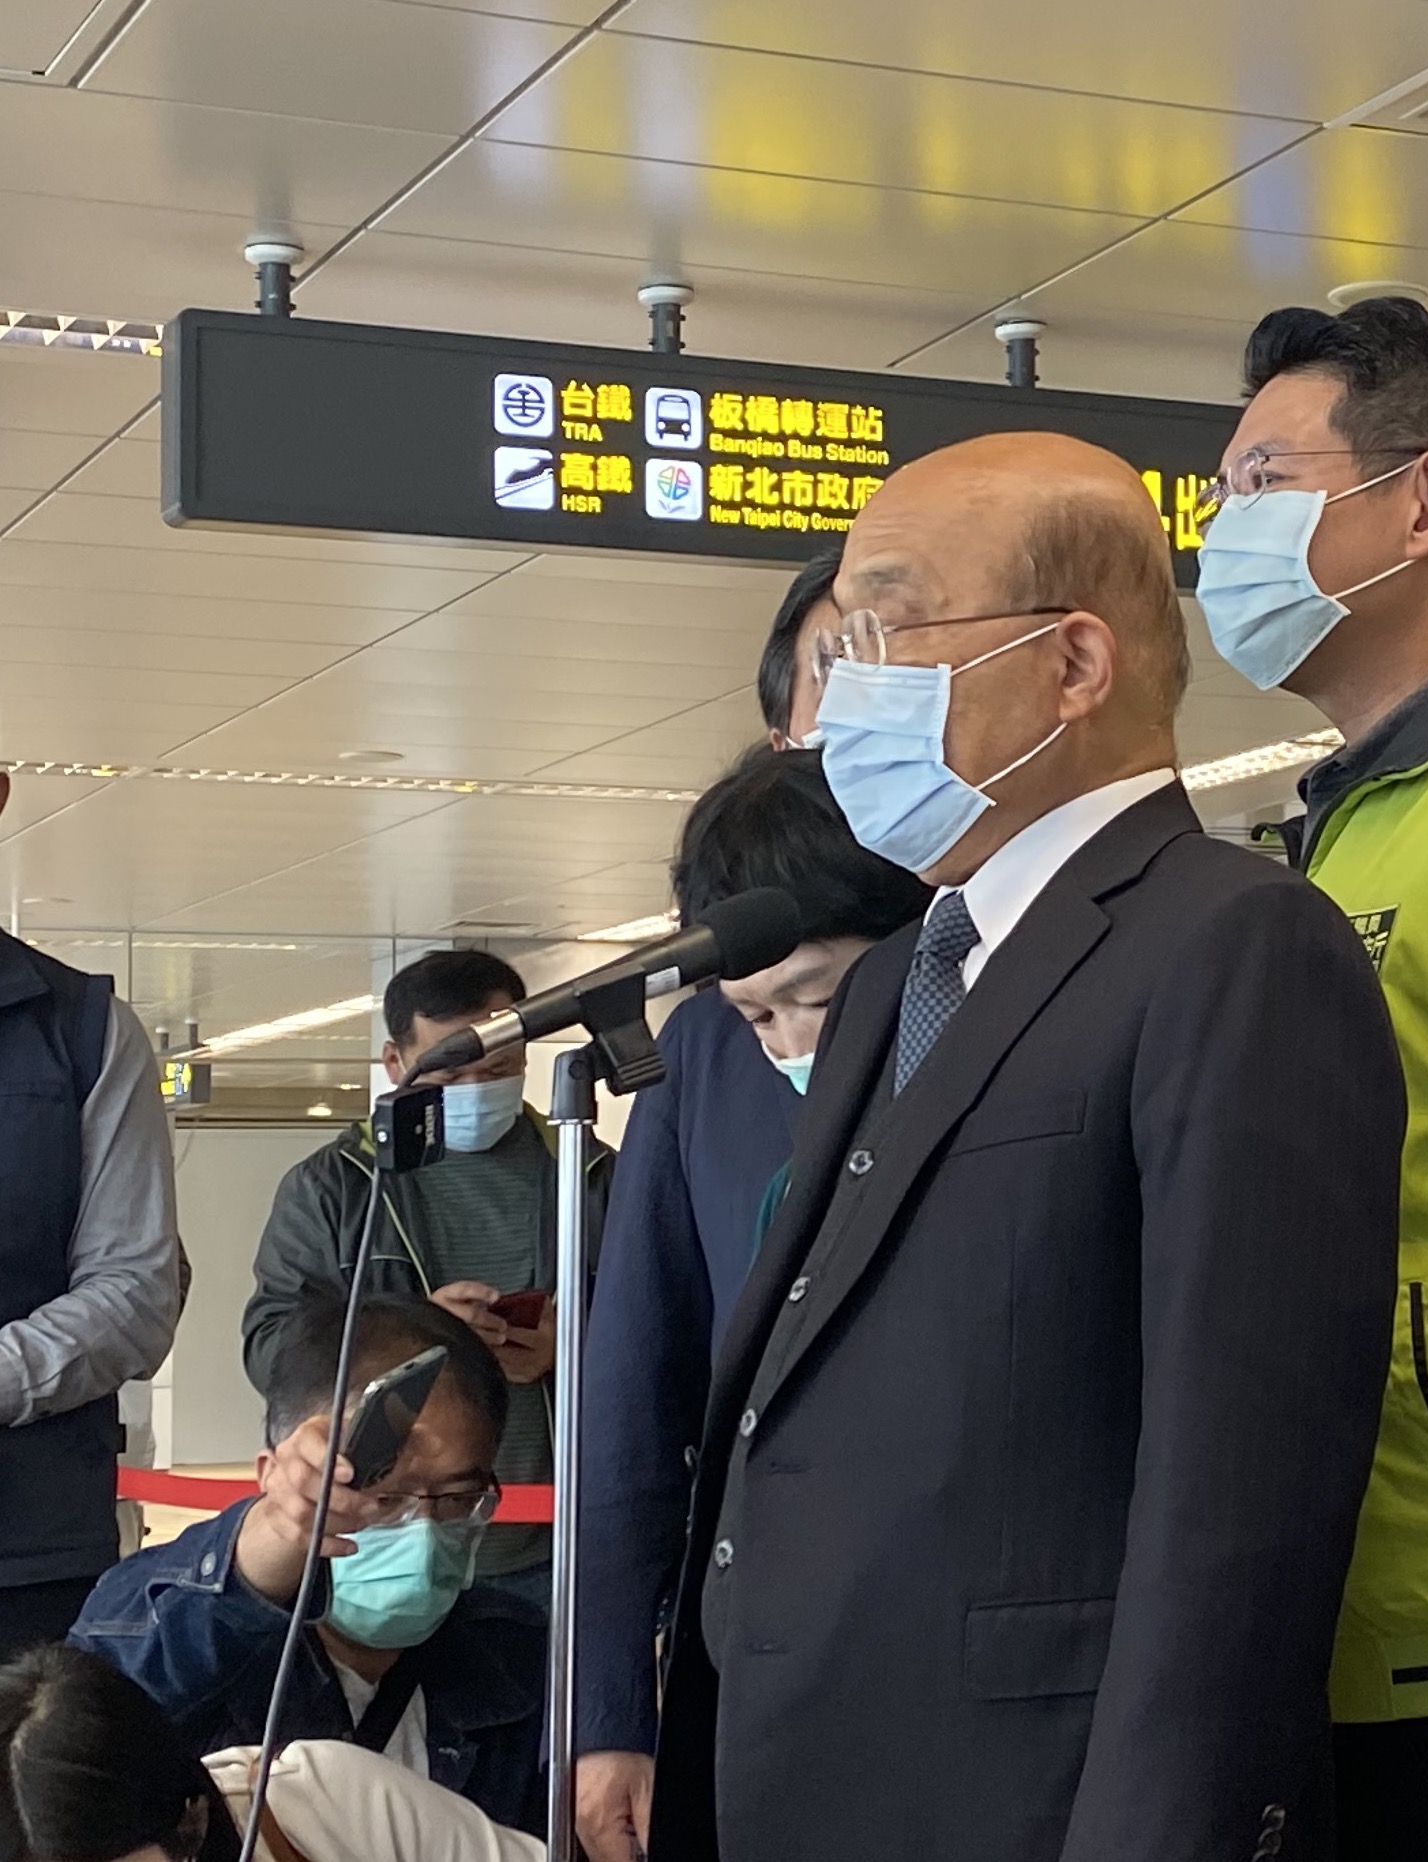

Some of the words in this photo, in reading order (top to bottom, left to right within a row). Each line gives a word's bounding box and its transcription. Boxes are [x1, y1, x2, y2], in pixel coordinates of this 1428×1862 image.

[560, 380, 633, 422] 台鐵
[709, 392, 883, 442] 板橋轉運站
[561, 420, 603, 442] TRA
[709, 433, 784, 458] Banqiao
[787, 439, 822, 460] Bus
[825, 443, 890, 466] Station
[560, 452, 633, 493] 高鐵
[561, 493, 602, 513] HSR
[710, 504, 741, 523] New
[742, 507, 781, 529] Taipei
[782, 510, 809, 532] City
